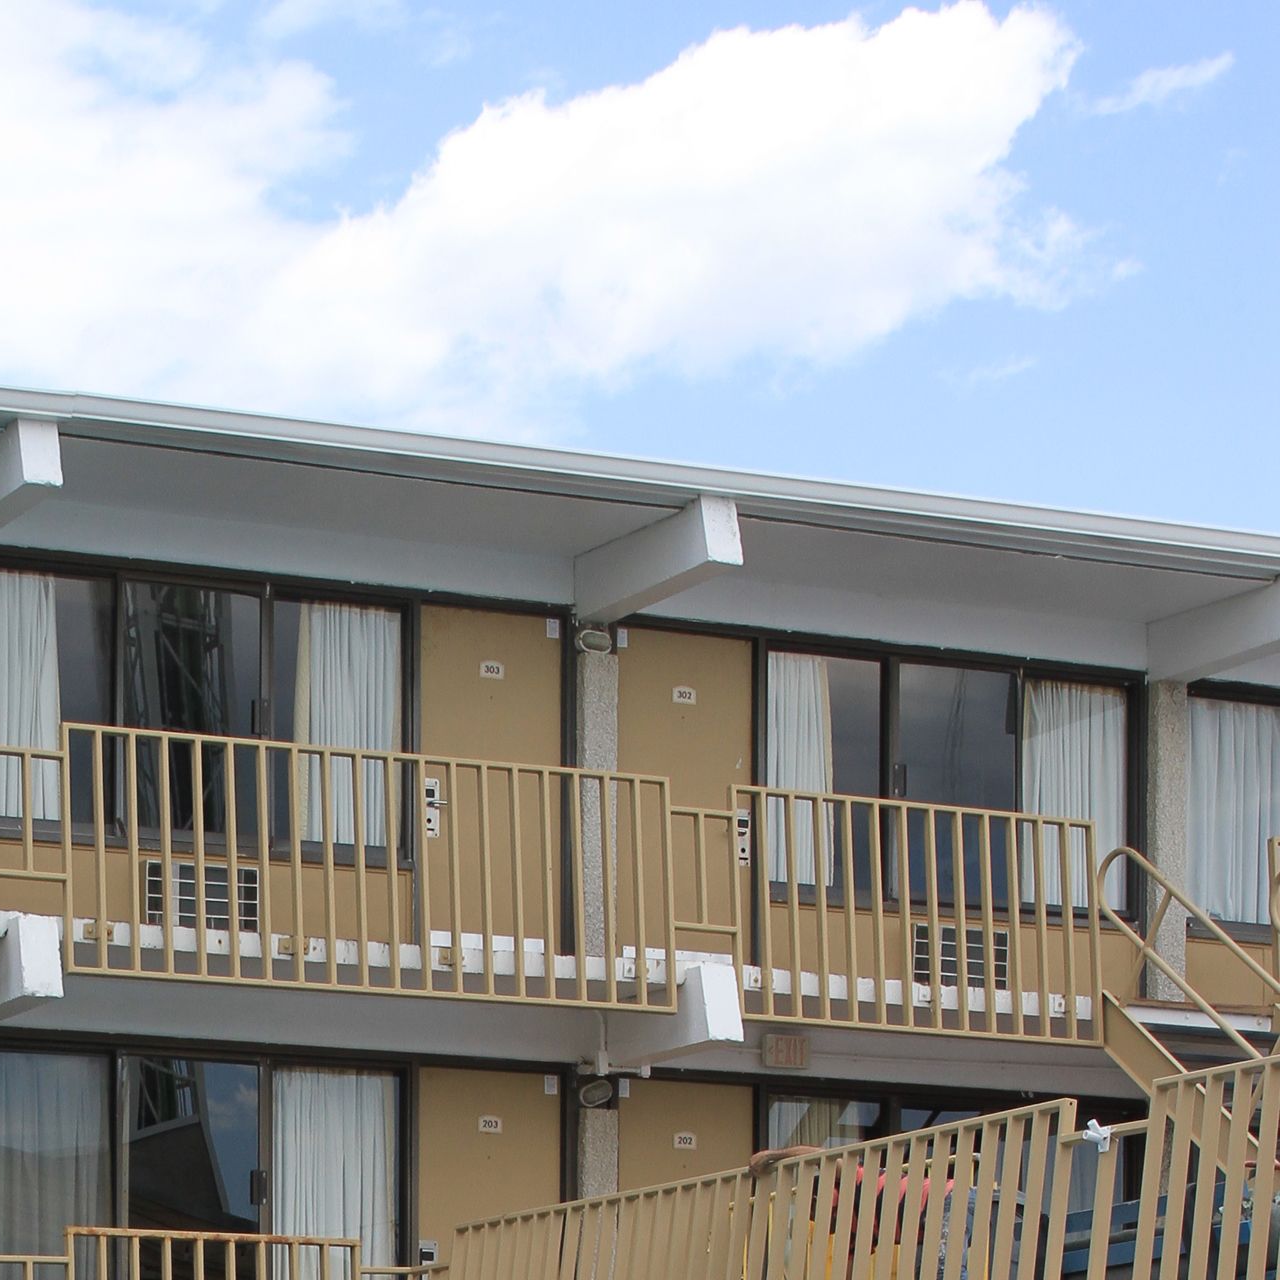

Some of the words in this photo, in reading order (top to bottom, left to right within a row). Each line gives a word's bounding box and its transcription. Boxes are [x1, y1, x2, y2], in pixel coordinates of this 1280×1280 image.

[483, 664, 500, 675] 303
[676, 690, 693, 700] 302
[775, 1036, 806, 1067] EXIT
[481, 1119, 499, 1129] 203
[677, 1136, 693, 1146] 202
